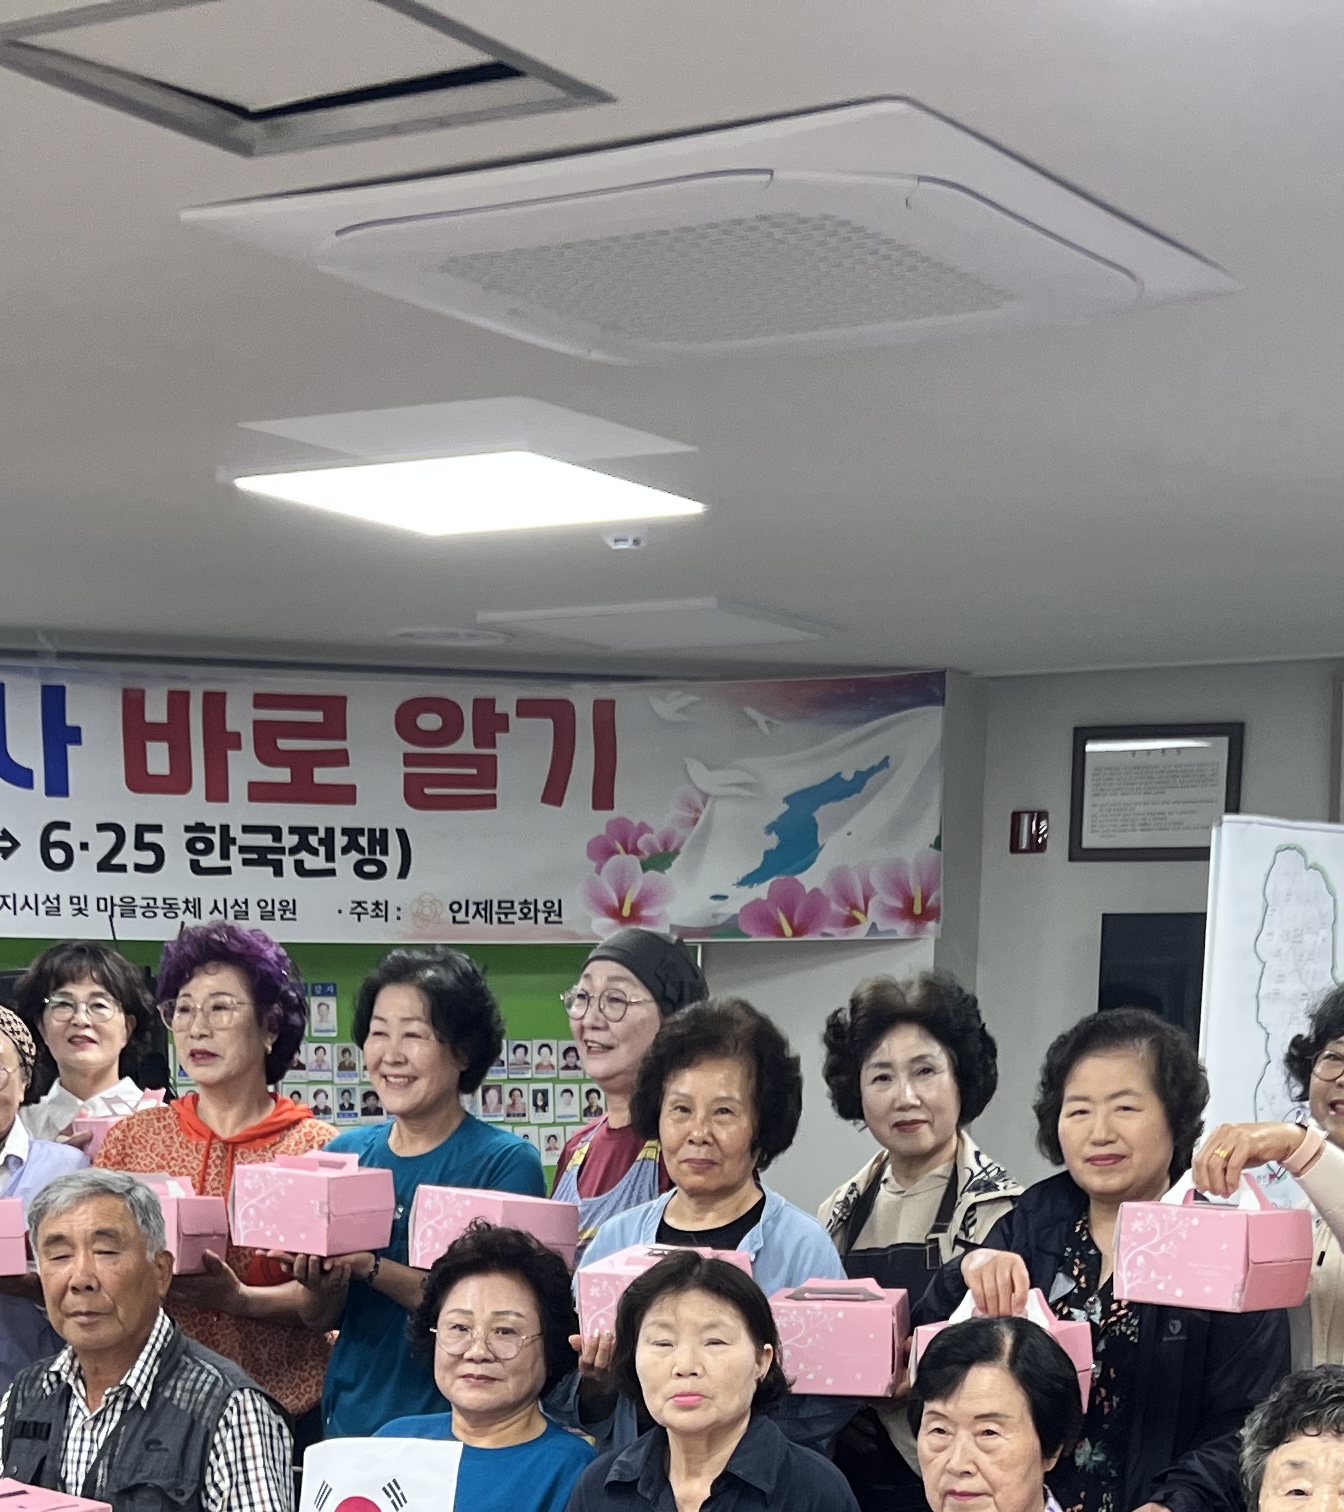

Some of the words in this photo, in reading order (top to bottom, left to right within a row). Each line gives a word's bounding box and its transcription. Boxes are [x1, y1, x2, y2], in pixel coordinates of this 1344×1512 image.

[121, 686, 358, 806] 바로
[393, 696, 618, 812] 알기
[183, 822, 413, 881] 한국전쟁)
[68, 894, 90, 918] 및
[96, 895, 202, 920] 마을공동체
[209, 897, 250, 921] 시설
[256, 898, 297, 922] 일원
[349, 899, 389, 923] 주최
[448, 898, 564, 925] 인제문화원
